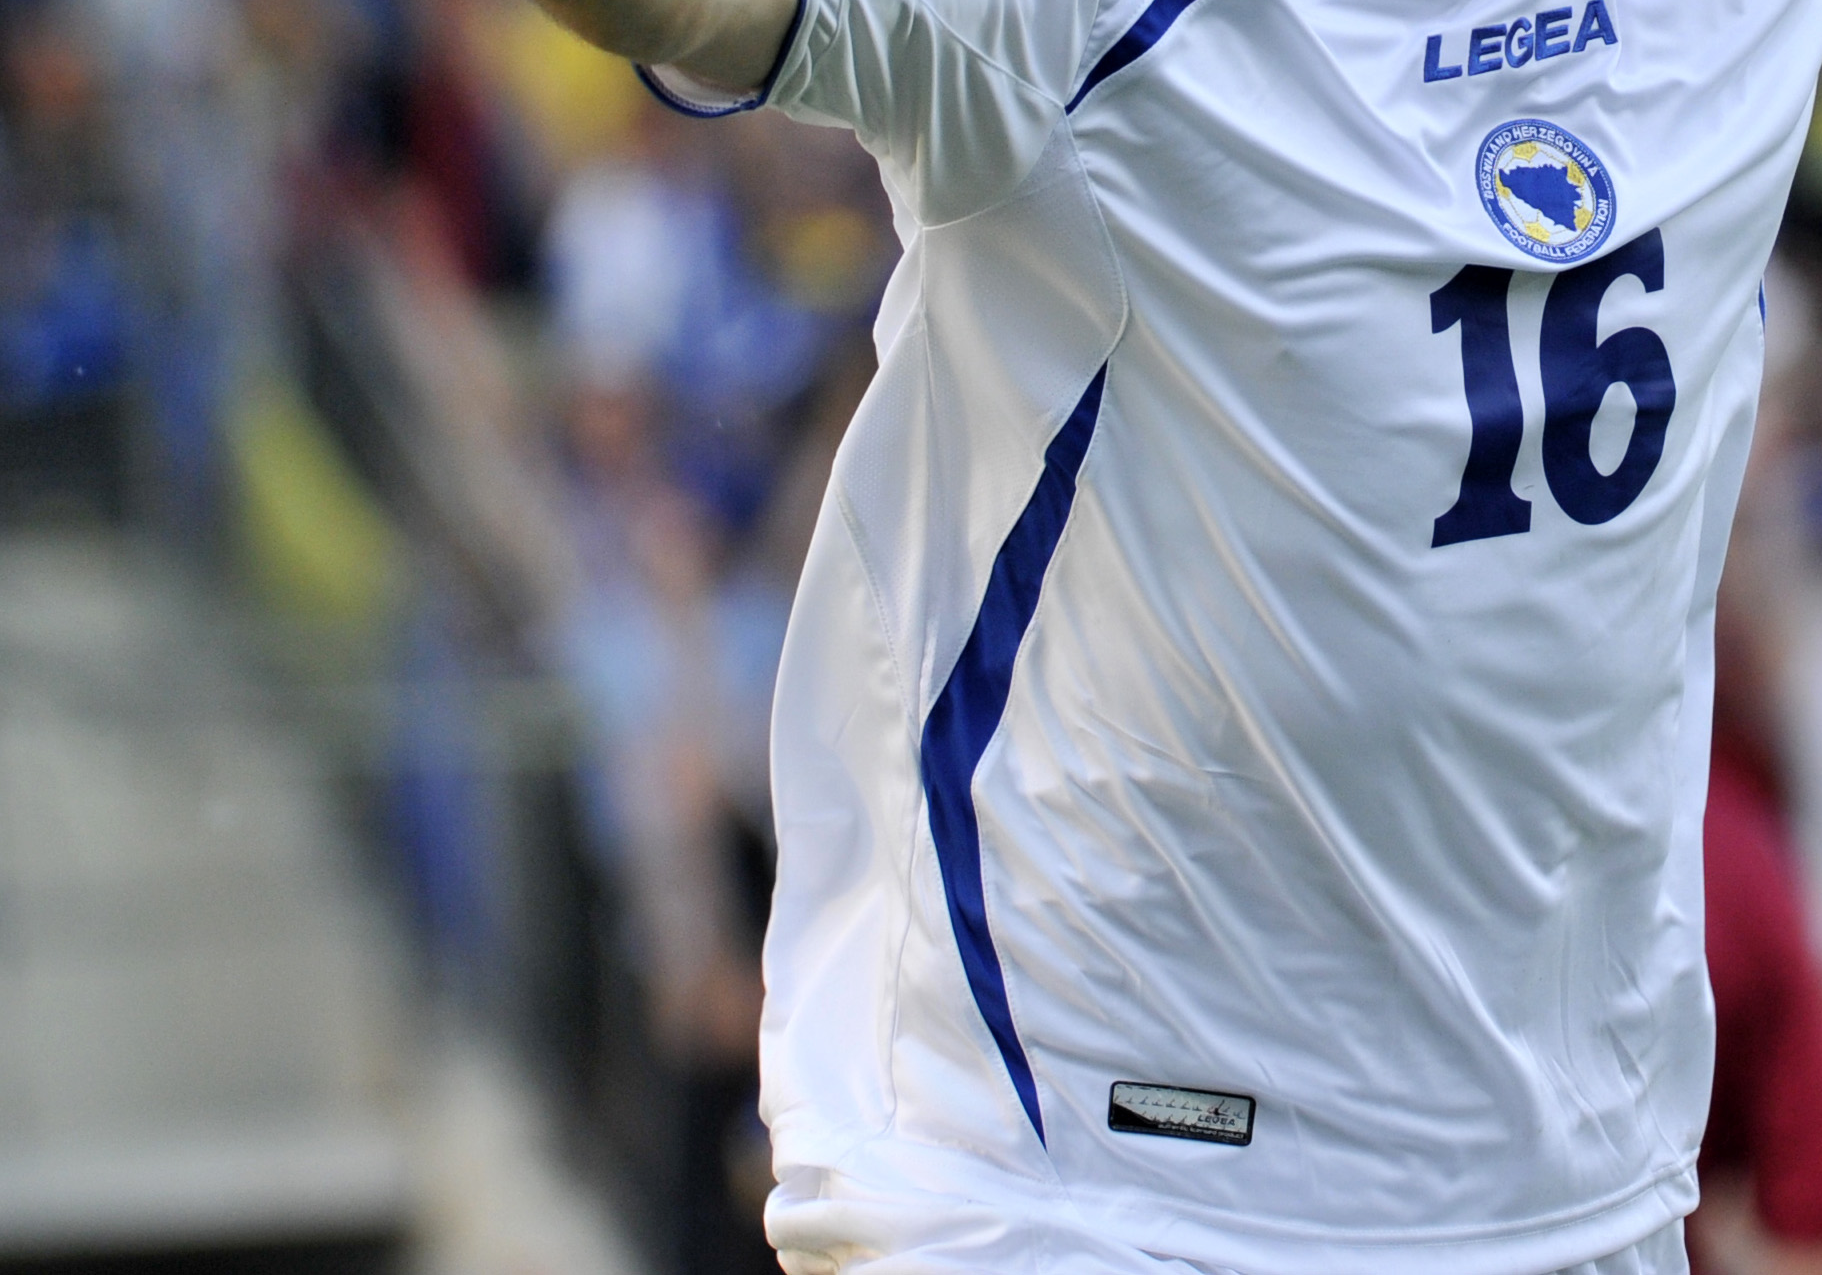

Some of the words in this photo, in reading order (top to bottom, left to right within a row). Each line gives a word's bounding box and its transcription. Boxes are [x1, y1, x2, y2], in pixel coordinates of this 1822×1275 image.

[1481, 153, 1495, 199] BOSNIA
[1491, 132, 1511, 153] AND
[1511, 125, 1600, 177] HERZEGOVINA
[1502, 222, 1566, 257] FOOTBALL
[1564, 198, 1609, 256] FEDERATION
[1429, 226, 1677, 549] 16
